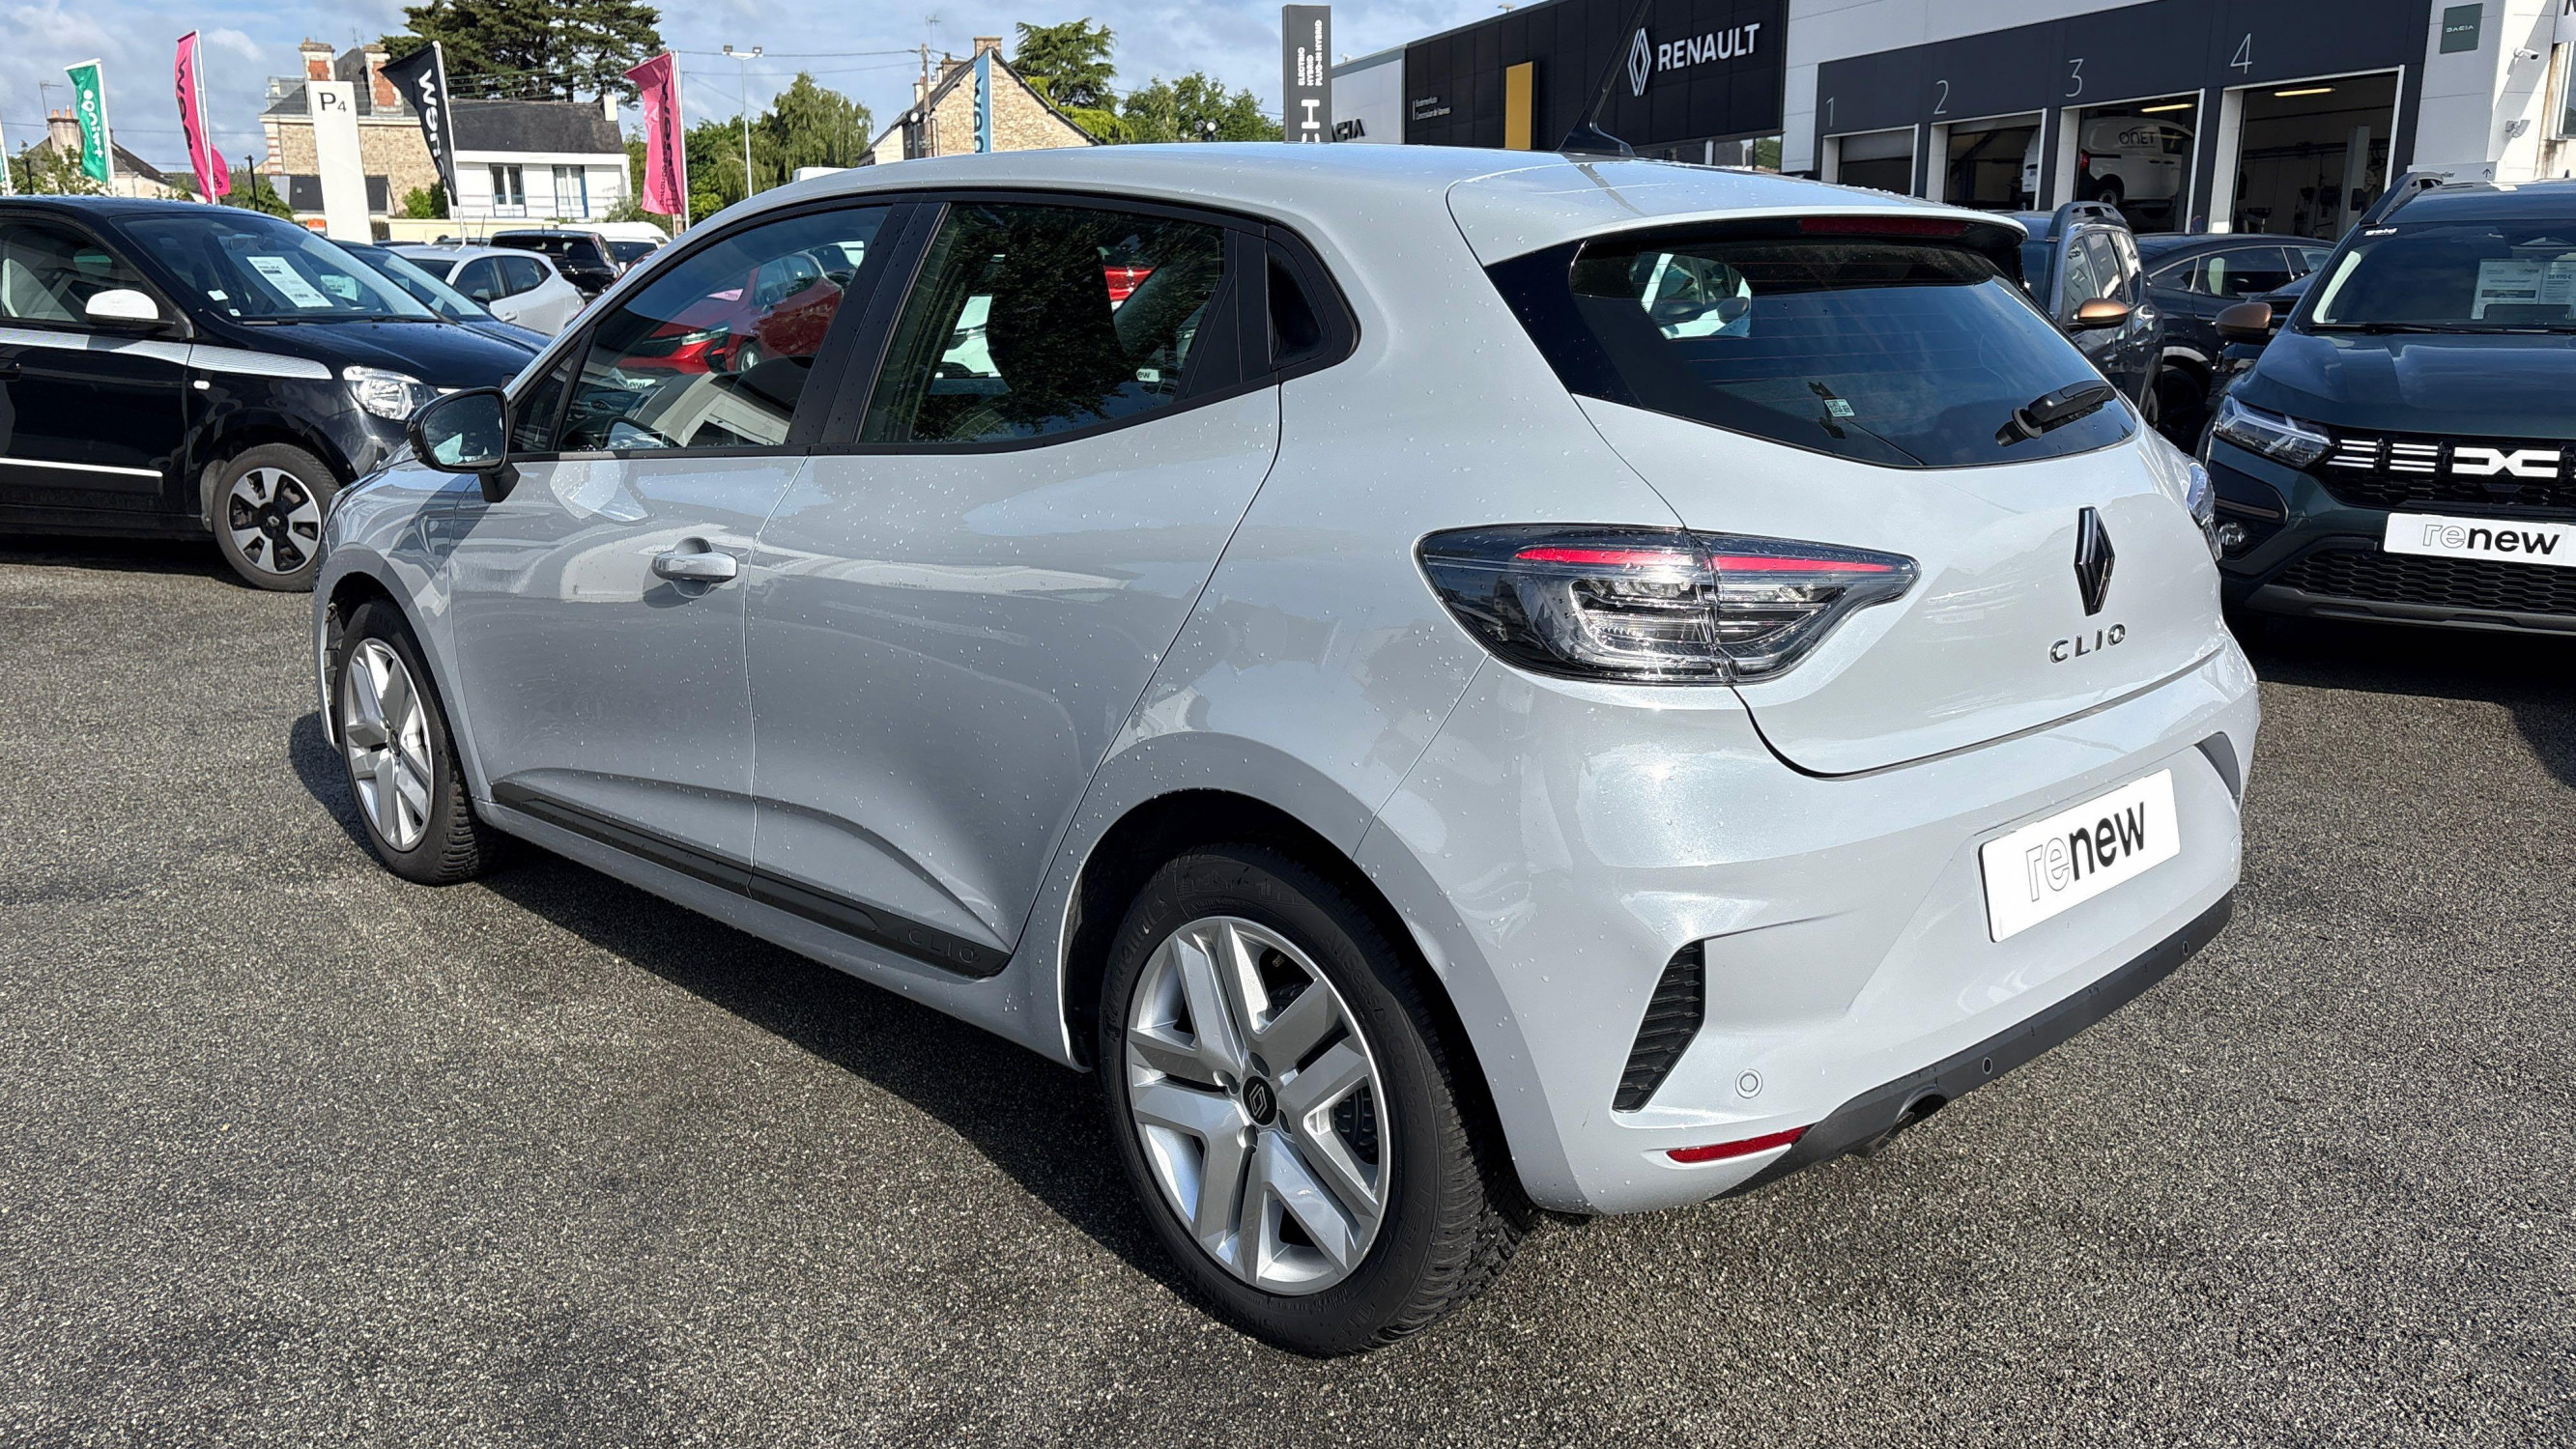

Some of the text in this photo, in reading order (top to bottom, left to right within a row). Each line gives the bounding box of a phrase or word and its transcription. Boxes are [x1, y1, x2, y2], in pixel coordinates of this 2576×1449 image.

[1657, 22, 1760, 72] RENAULT
[2446, 24, 2474, 33] DACIA
[2230, 33, 2252, 74] 4
[2065, 58, 2083, 98] 3
[1826, 97, 1834, 128] 1
[1933, 80, 1949, 115] 2
[2422, 524, 2561, 555] renew
[2049, 623, 2126, 664] CLIO
[2025, 801, 2144, 902] renew
[909, 927, 974, 963] CLIO
